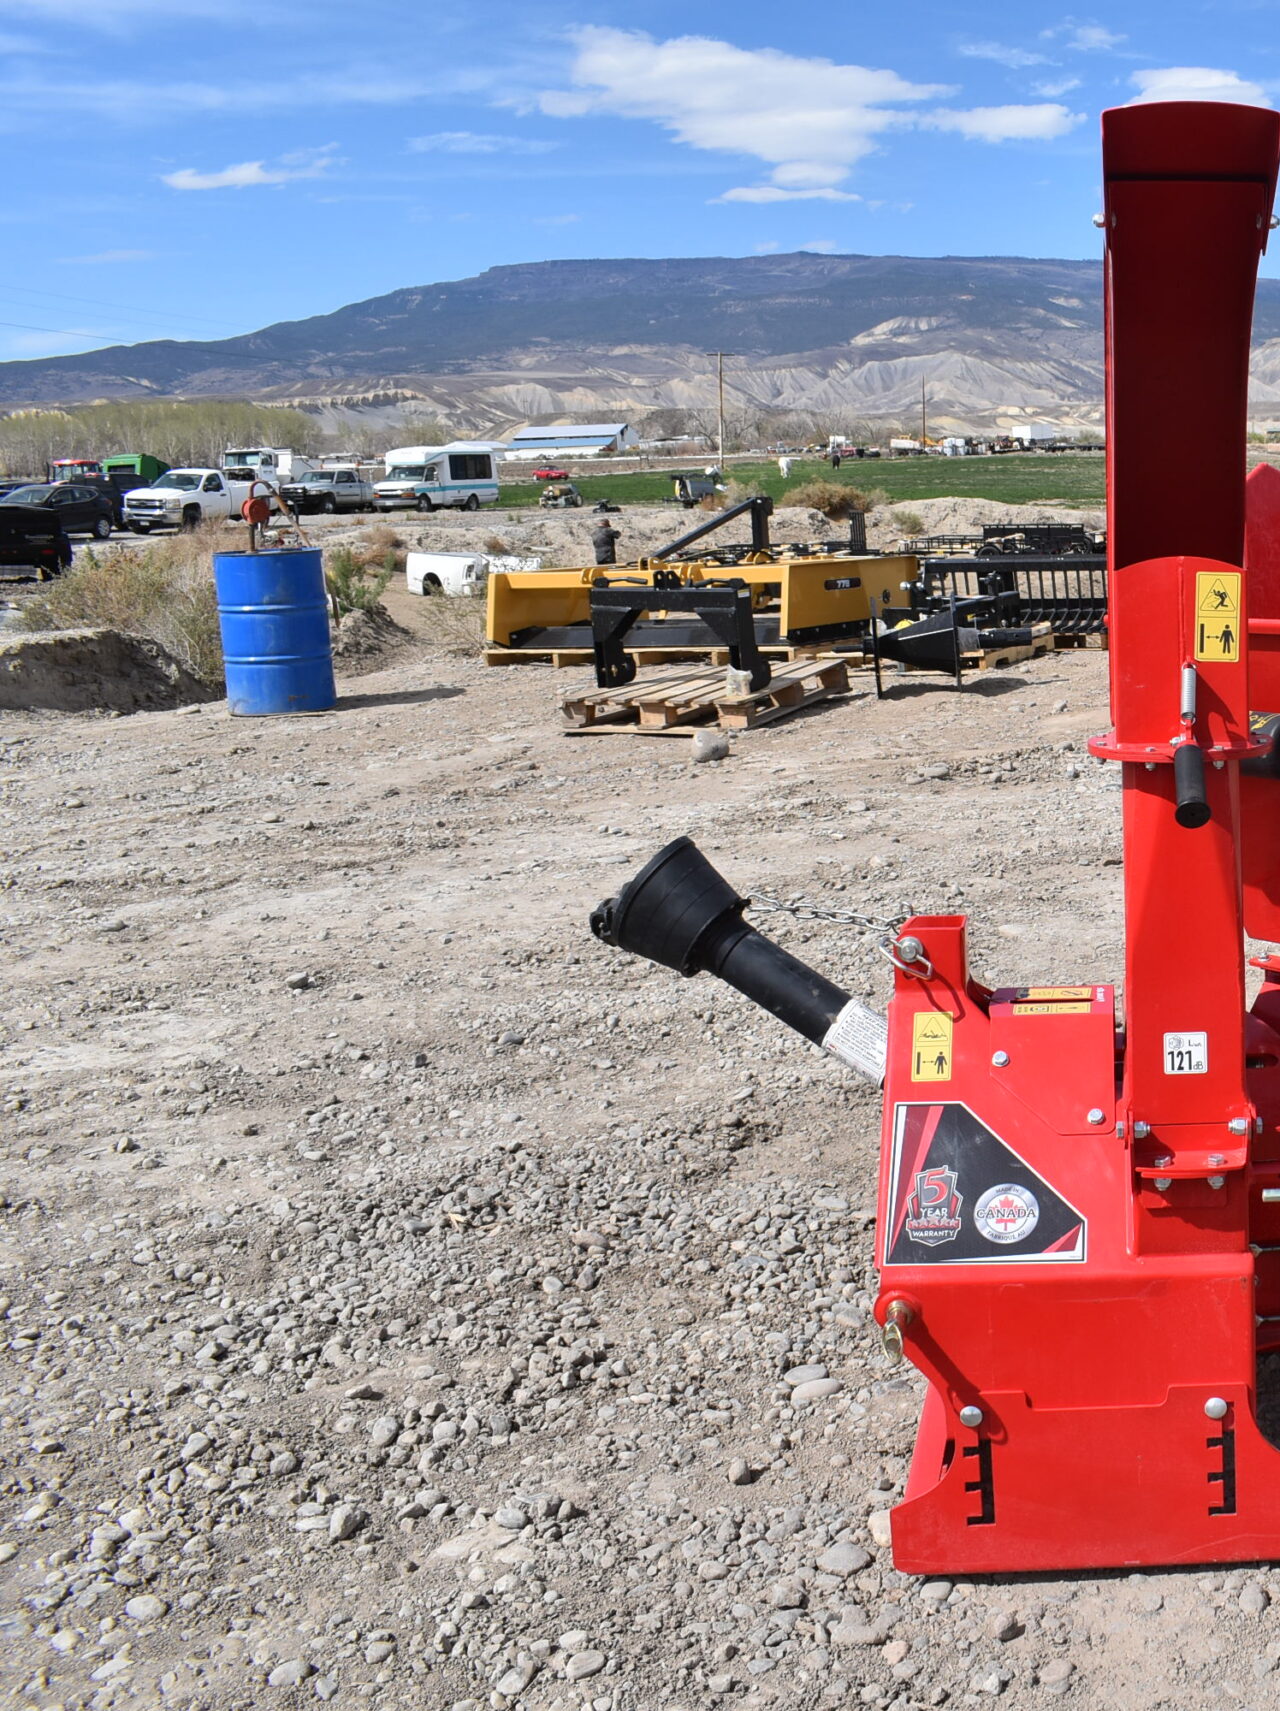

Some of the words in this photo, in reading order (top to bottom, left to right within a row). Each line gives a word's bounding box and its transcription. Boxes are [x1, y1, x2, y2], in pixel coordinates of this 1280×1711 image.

[1167, 1050, 1192, 1071] 121
[922, 1168, 949, 1206] 5
[920, 1207, 949, 1218] YEAR
[976, 1208, 1037, 1220] CANADA
[912, 1230, 954, 1238] WARRANTY
